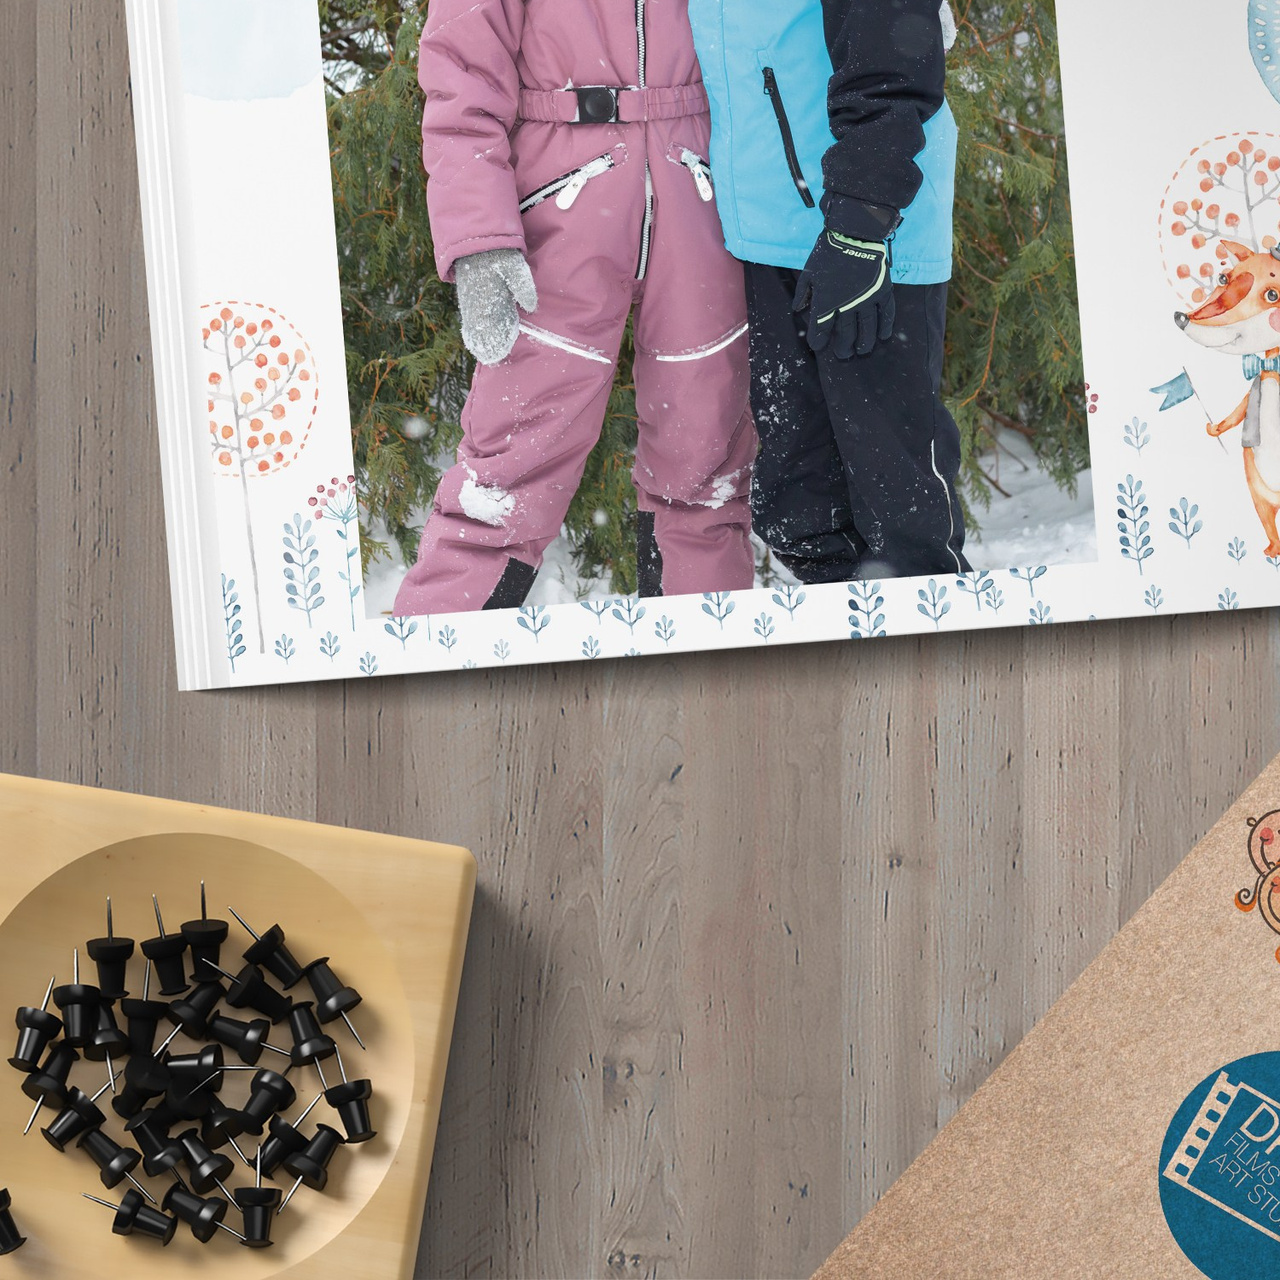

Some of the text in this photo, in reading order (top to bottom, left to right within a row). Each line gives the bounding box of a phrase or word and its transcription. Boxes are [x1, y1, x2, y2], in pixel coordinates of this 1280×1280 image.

[842, 248, 877, 261] ziener
[1208, 1153, 1253, 1188] ART
[1223, 1131, 1280, 1186] FILMS
